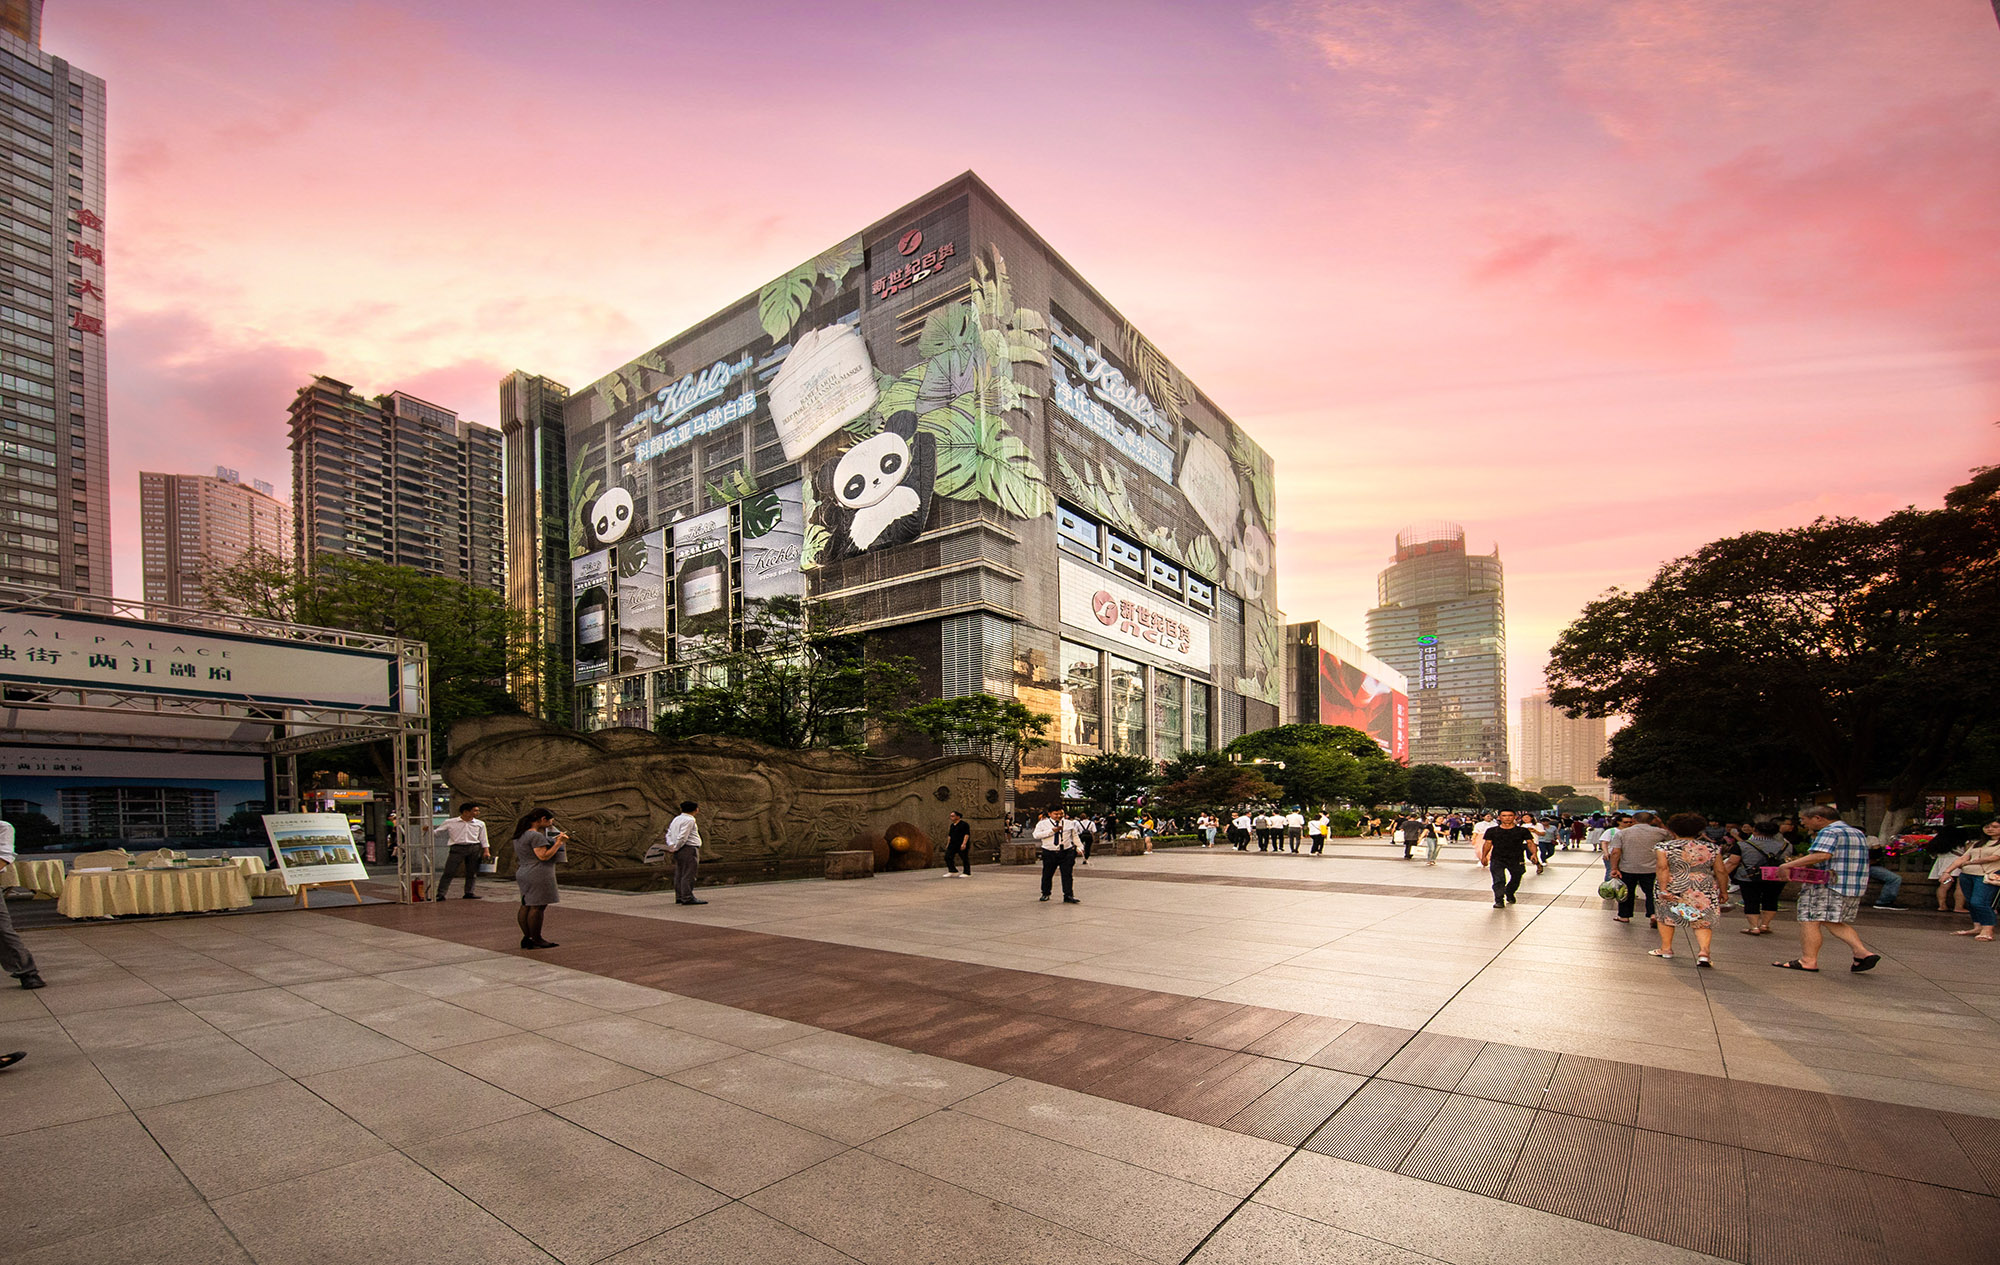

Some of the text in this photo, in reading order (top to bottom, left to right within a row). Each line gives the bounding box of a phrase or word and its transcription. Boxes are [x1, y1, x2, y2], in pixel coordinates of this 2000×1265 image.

[872, 242, 955, 295] 新世纪百货
[653, 361, 731, 422] Kiehl's
[1056, 381, 1118, 435] 净化毛孔
[1079, 346, 1154, 427] Kiehl's
[636, 392, 757, 461] 科颜氏亚马逊白泥
[748, 544, 798, 573] Kiehl's
[1120, 600, 1190, 644] 新世纪百货
[88, 652, 232, 681] 两江融府
[94, 636, 232, 659] PALACE
[1424, 646, 1437, 689] 中国民生银行
